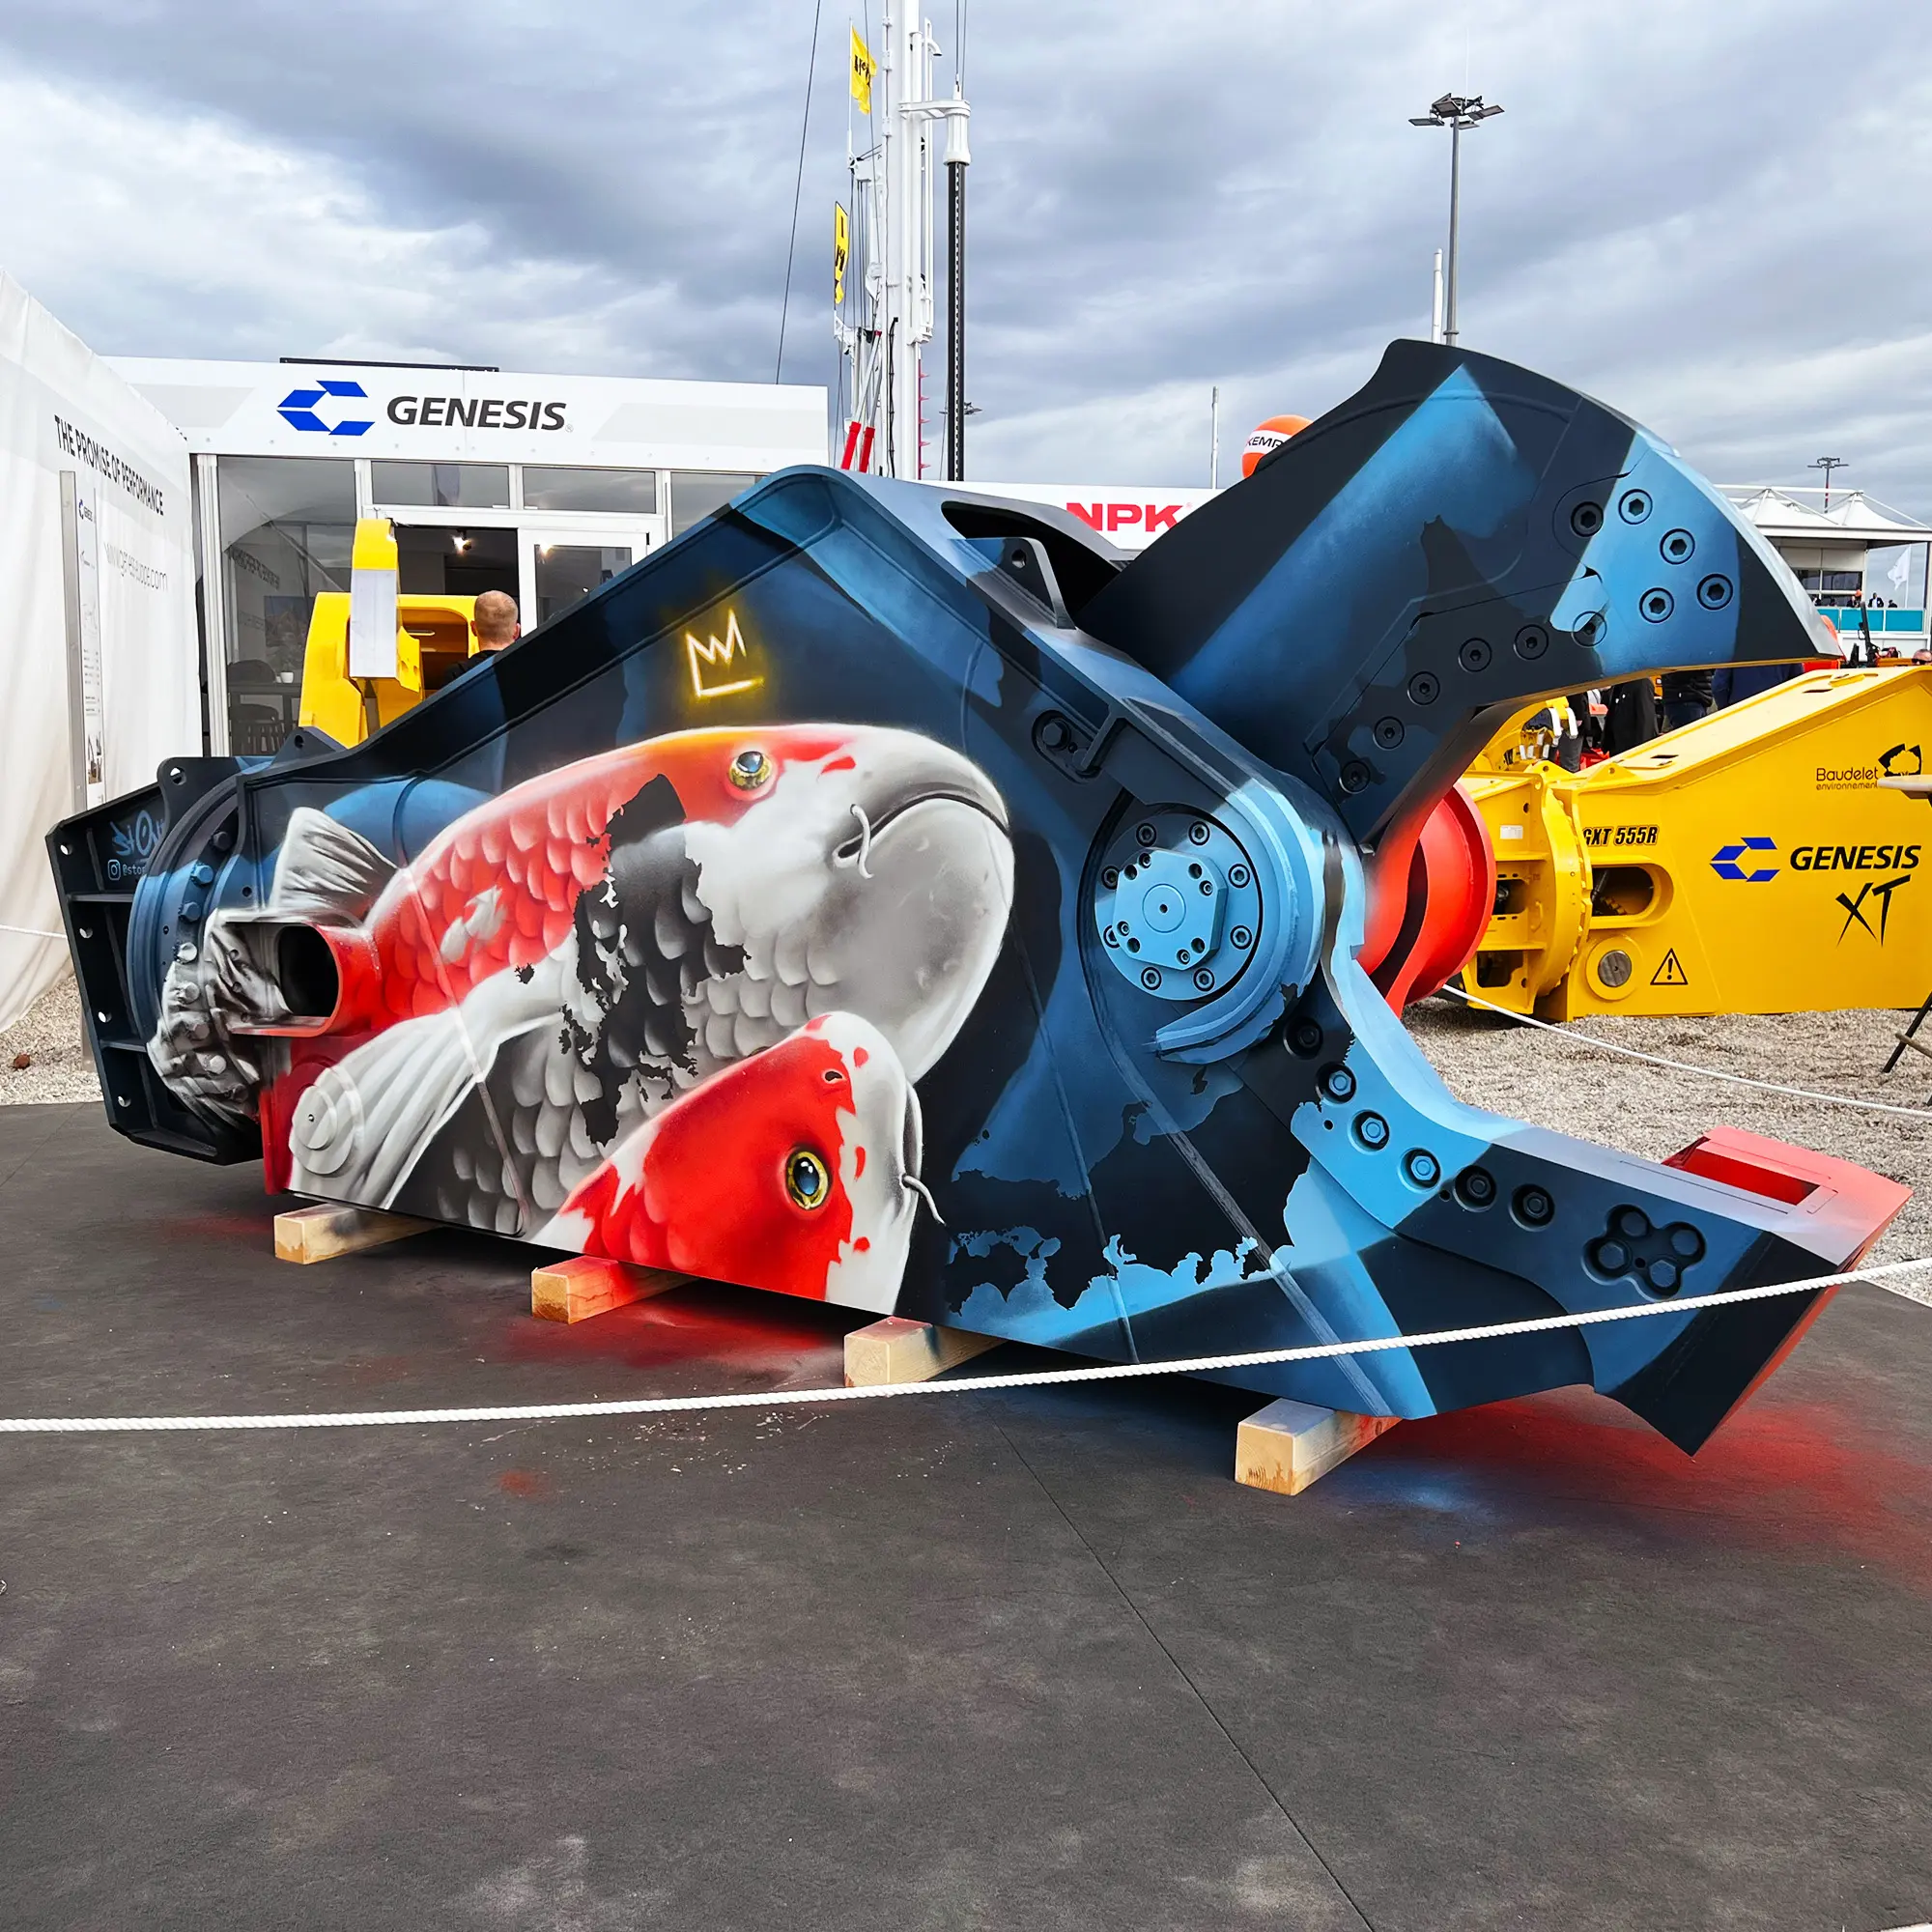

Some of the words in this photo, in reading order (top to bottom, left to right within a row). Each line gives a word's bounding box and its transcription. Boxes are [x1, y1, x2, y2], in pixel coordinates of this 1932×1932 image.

[386, 396, 567, 431] GENESIS
[54, 414, 75, 457] THE
[111, 454, 121, 485] OF
[1066, 502, 1183, 532] NPK
[1816, 767, 1879, 781] Baudelet
[1582, 827, 1613, 846] GXT
[1614, 826, 1659, 845] 555R
[1790, 844, 1921, 871] GENESIS
[1835, 874, 1911, 948] XT
